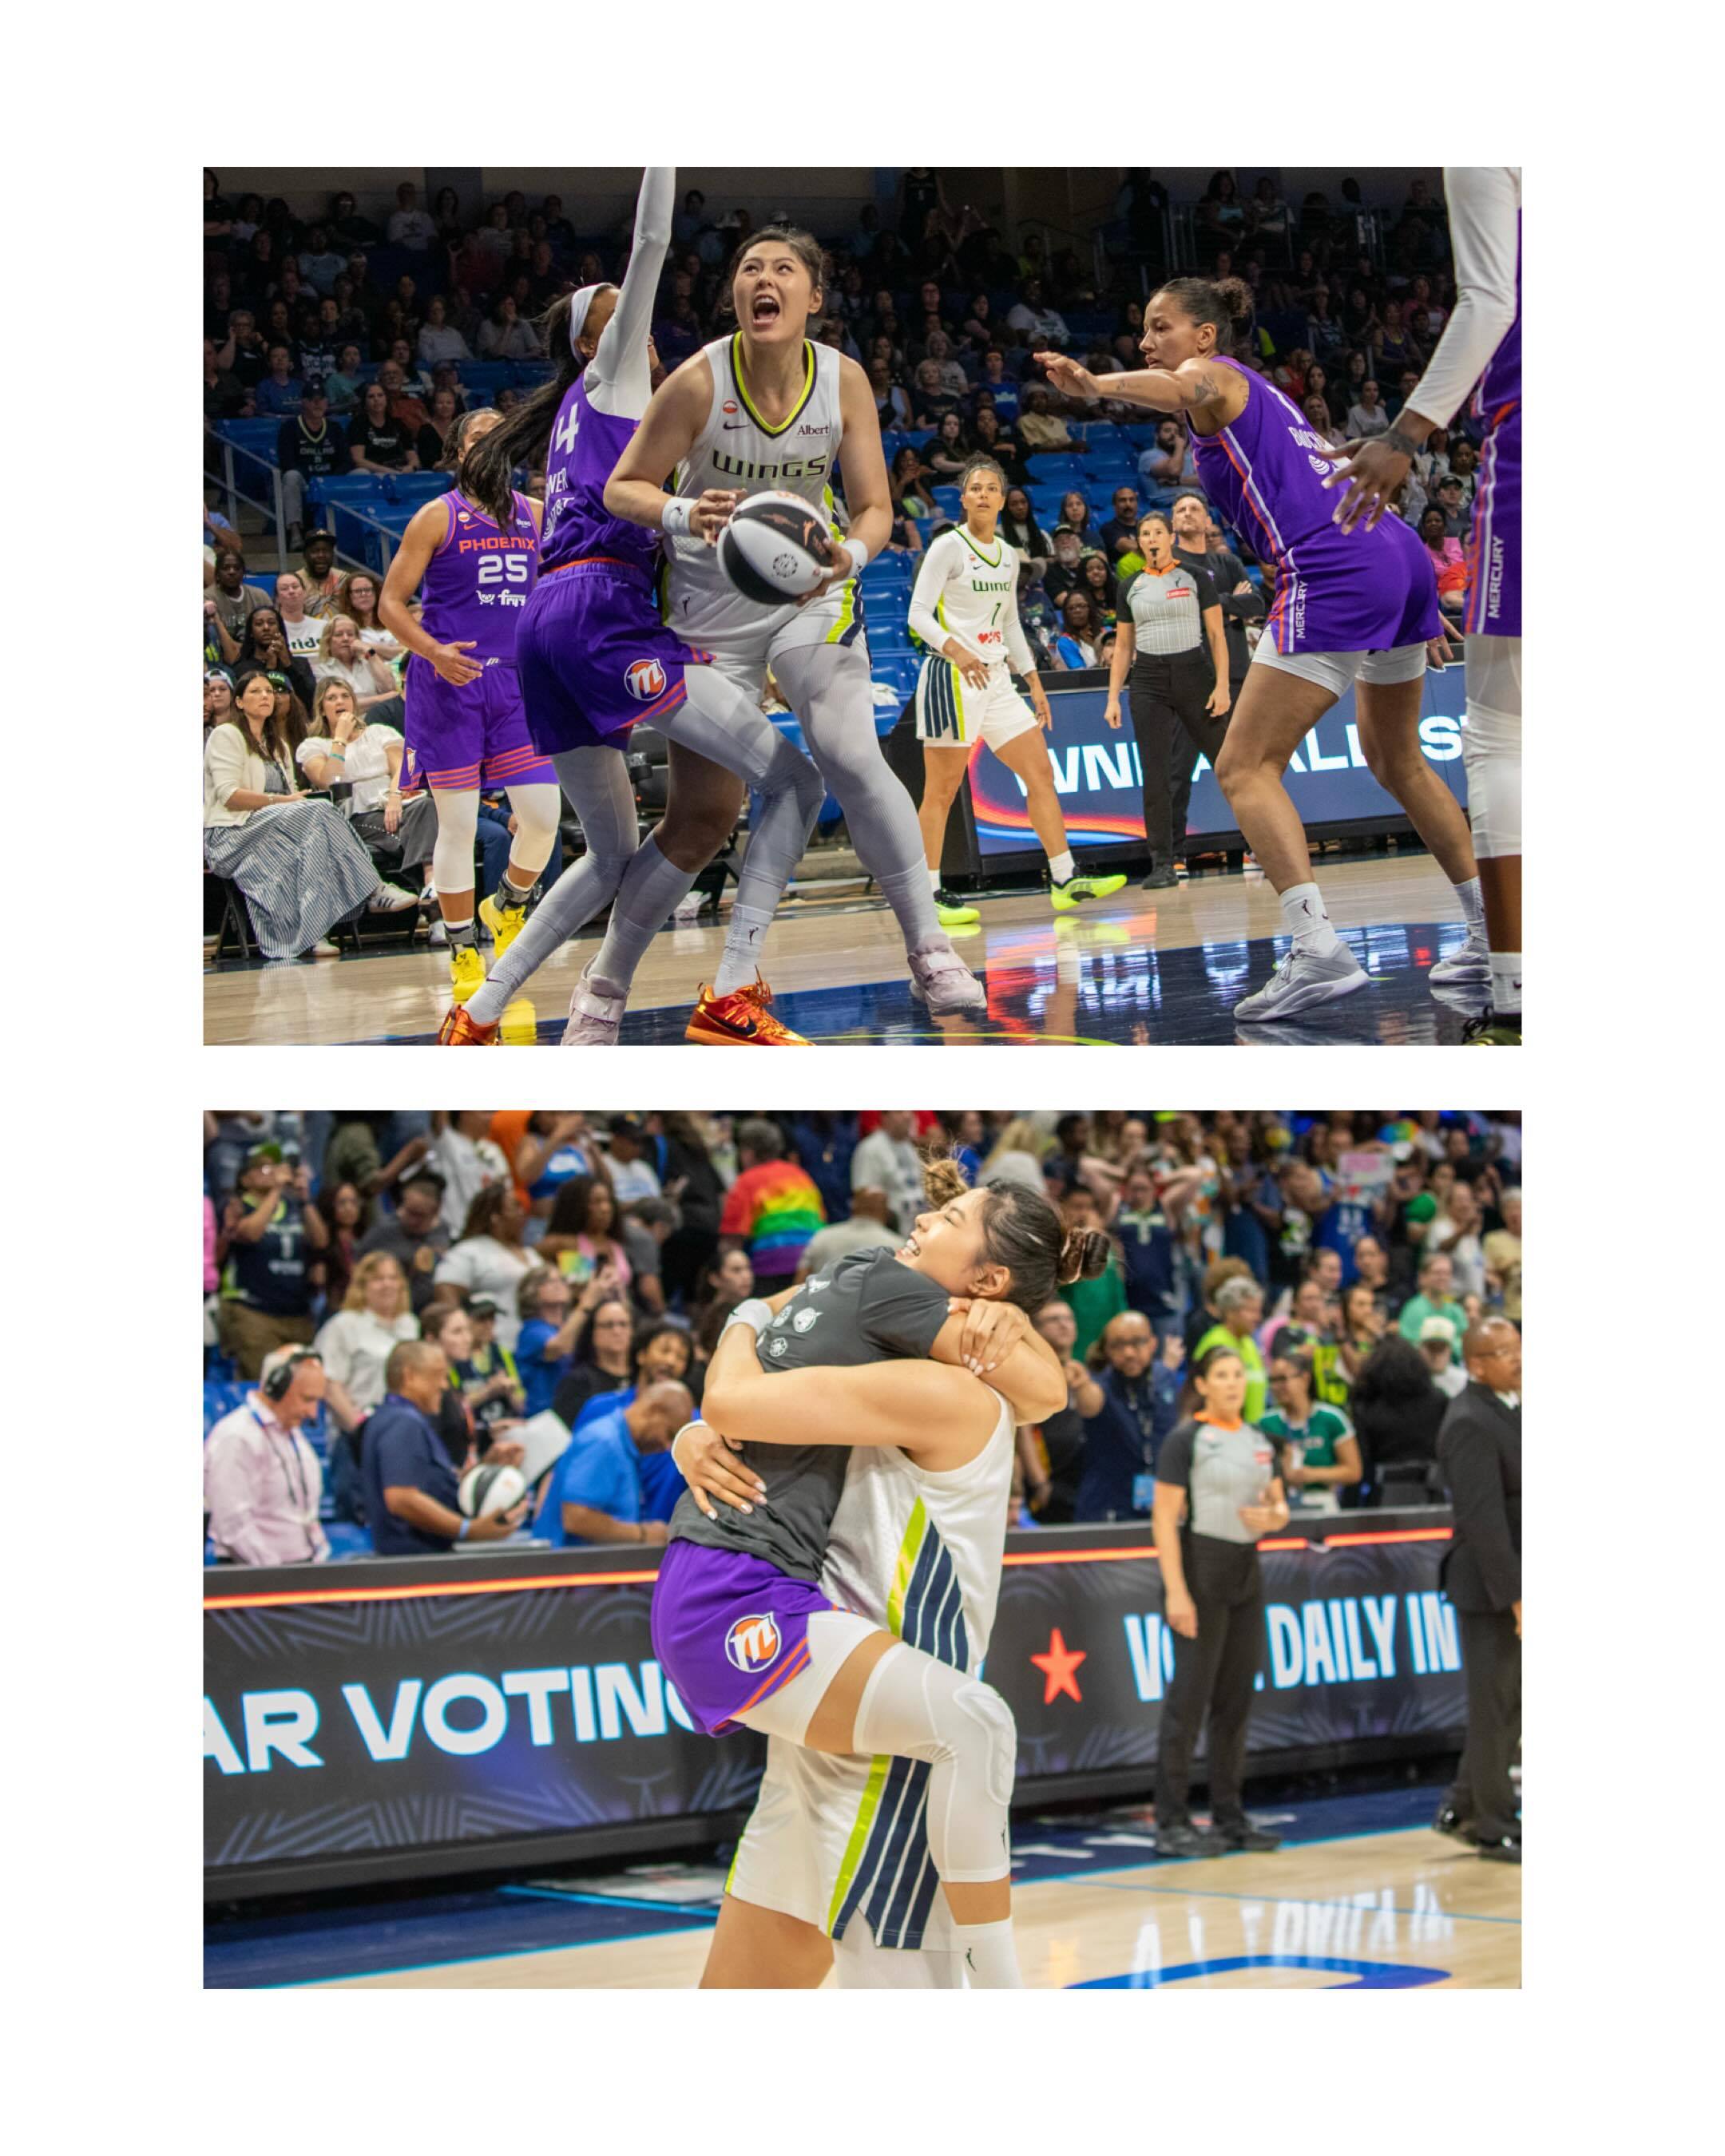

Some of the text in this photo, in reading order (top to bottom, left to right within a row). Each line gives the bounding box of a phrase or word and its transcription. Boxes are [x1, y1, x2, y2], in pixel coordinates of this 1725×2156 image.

[798, 424, 830, 436] Albert
[712, 449, 827, 479] WINGS
[458, 536, 536, 553] PHOENIX
[478, 553, 528, 584] 25
[1488, 535, 1505, 620] MERCURY
[1295, 581, 1309, 640] MERCURY
[1265, 1594, 1398, 1690] DAILY
[1404, 1590, 1462, 1674] IN
